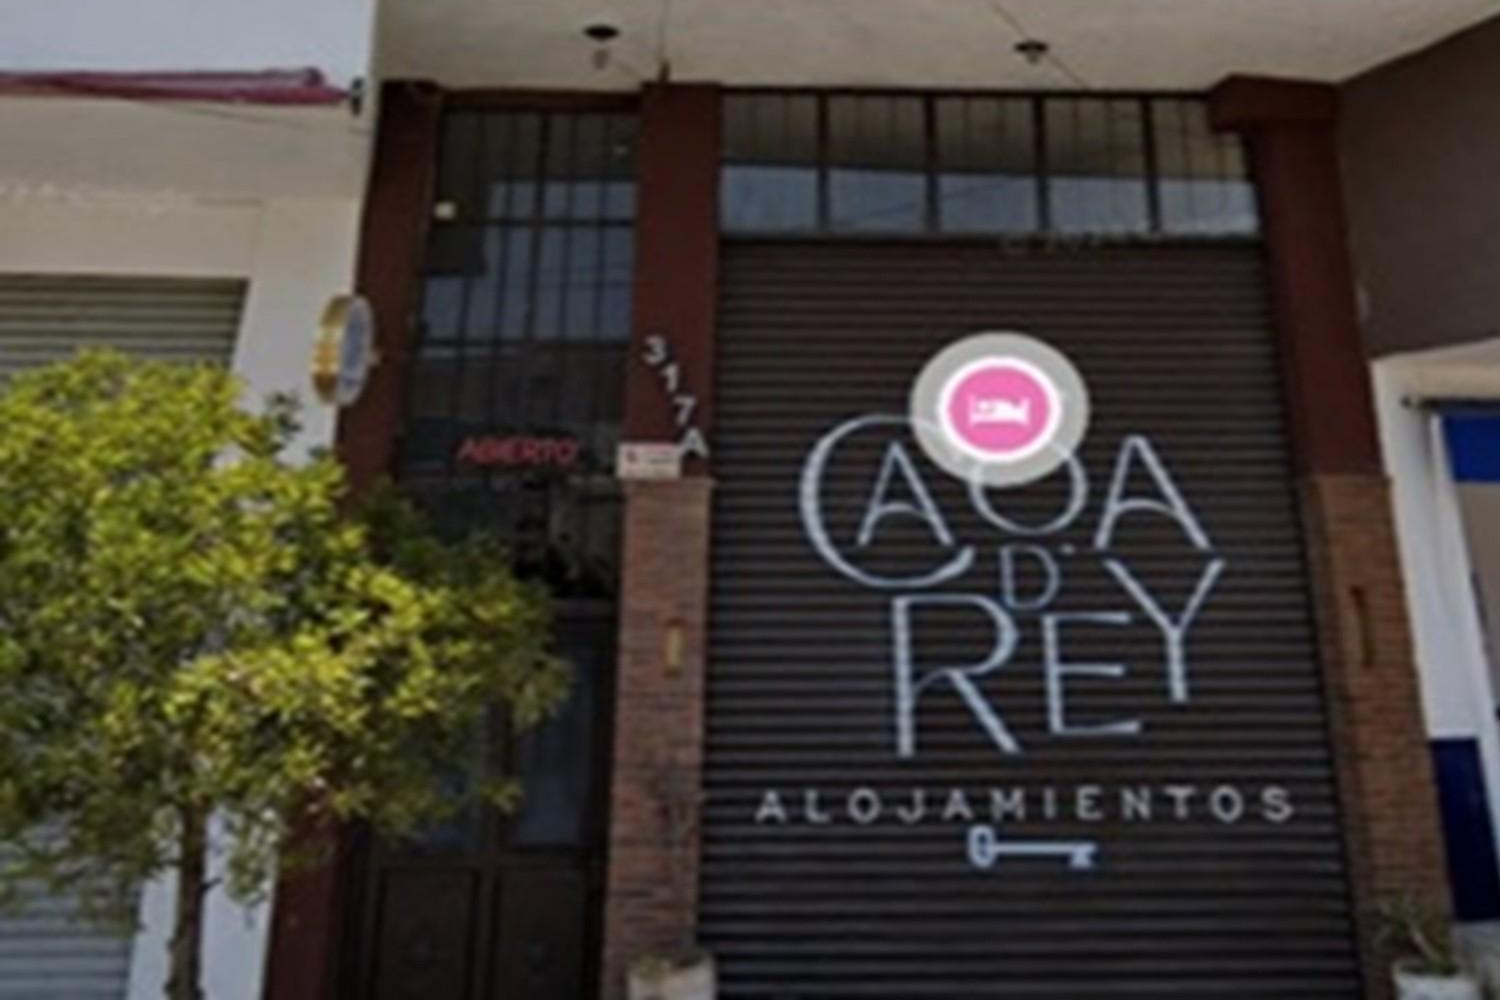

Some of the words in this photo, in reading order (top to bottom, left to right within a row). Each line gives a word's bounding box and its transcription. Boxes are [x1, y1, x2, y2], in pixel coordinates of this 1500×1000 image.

[456, 437, 580, 466] ABIERTO
[892, 559, 1225, 757] REY
[755, 786, 1294, 822] ALOJAMIENTOS
